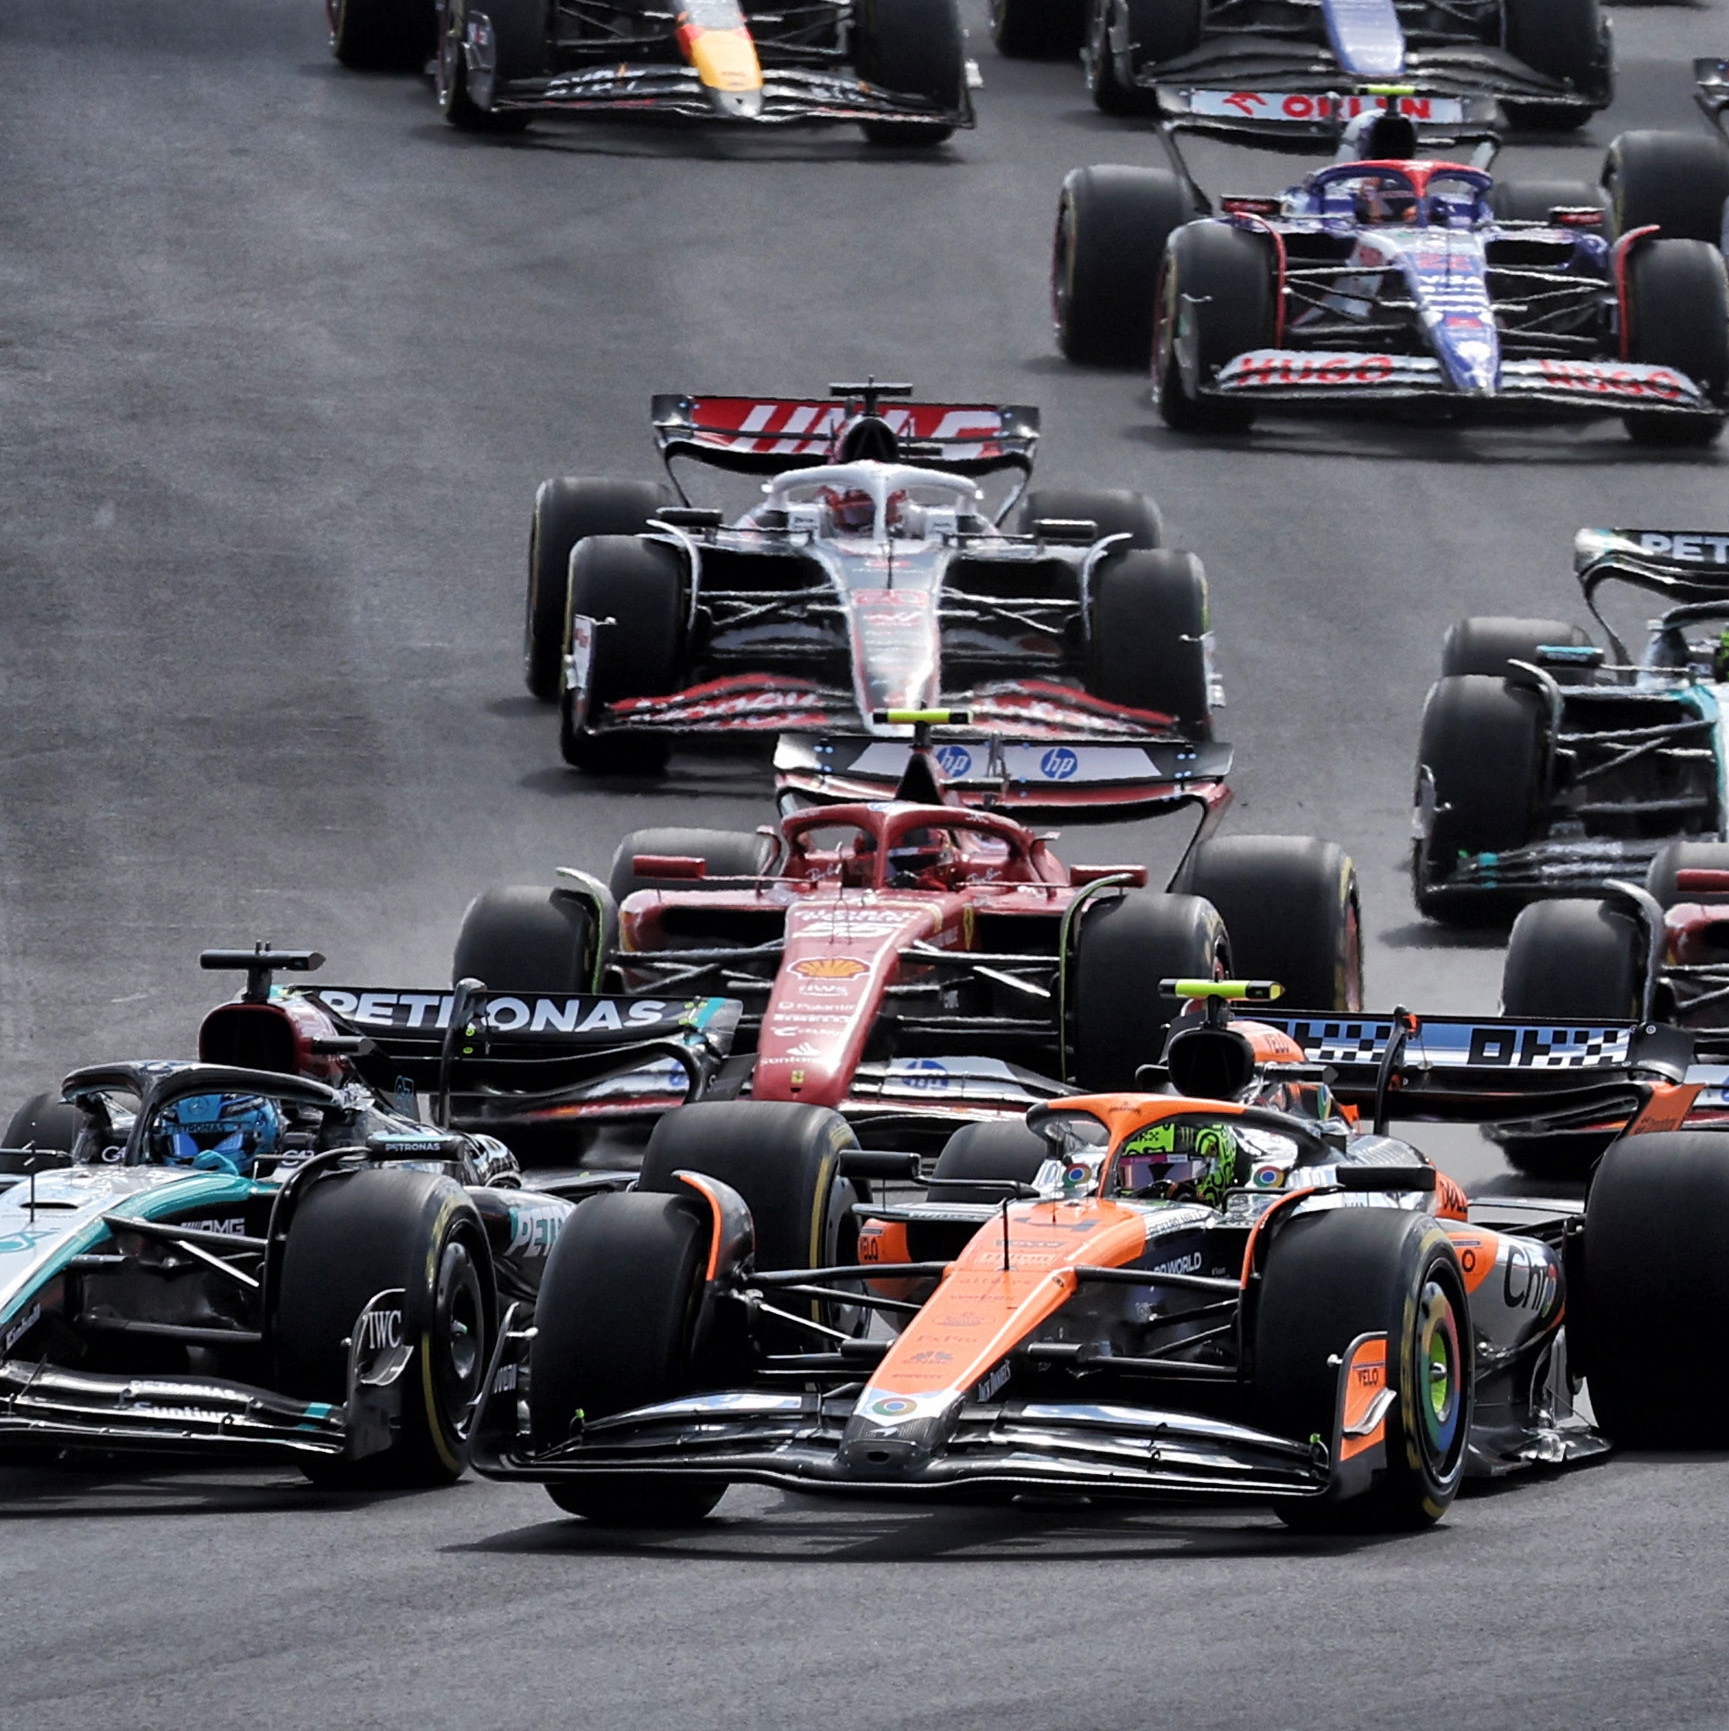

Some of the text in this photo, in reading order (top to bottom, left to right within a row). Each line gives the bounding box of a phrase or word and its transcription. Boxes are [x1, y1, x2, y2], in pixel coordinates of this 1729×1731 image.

[1237, 355, 1394, 386] HUGO
[939, 746, 971, 778] hp
[1043, 747, 1077, 780] hp
[101, 1145, 126, 1163] G4
[384, 1142, 441, 1153] PETRONAS
[1166, 1251, 1202, 1274] WORLD
[367, 1309, 402, 1350] IWC
[1357, 1369, 1379, 1386] VELO
